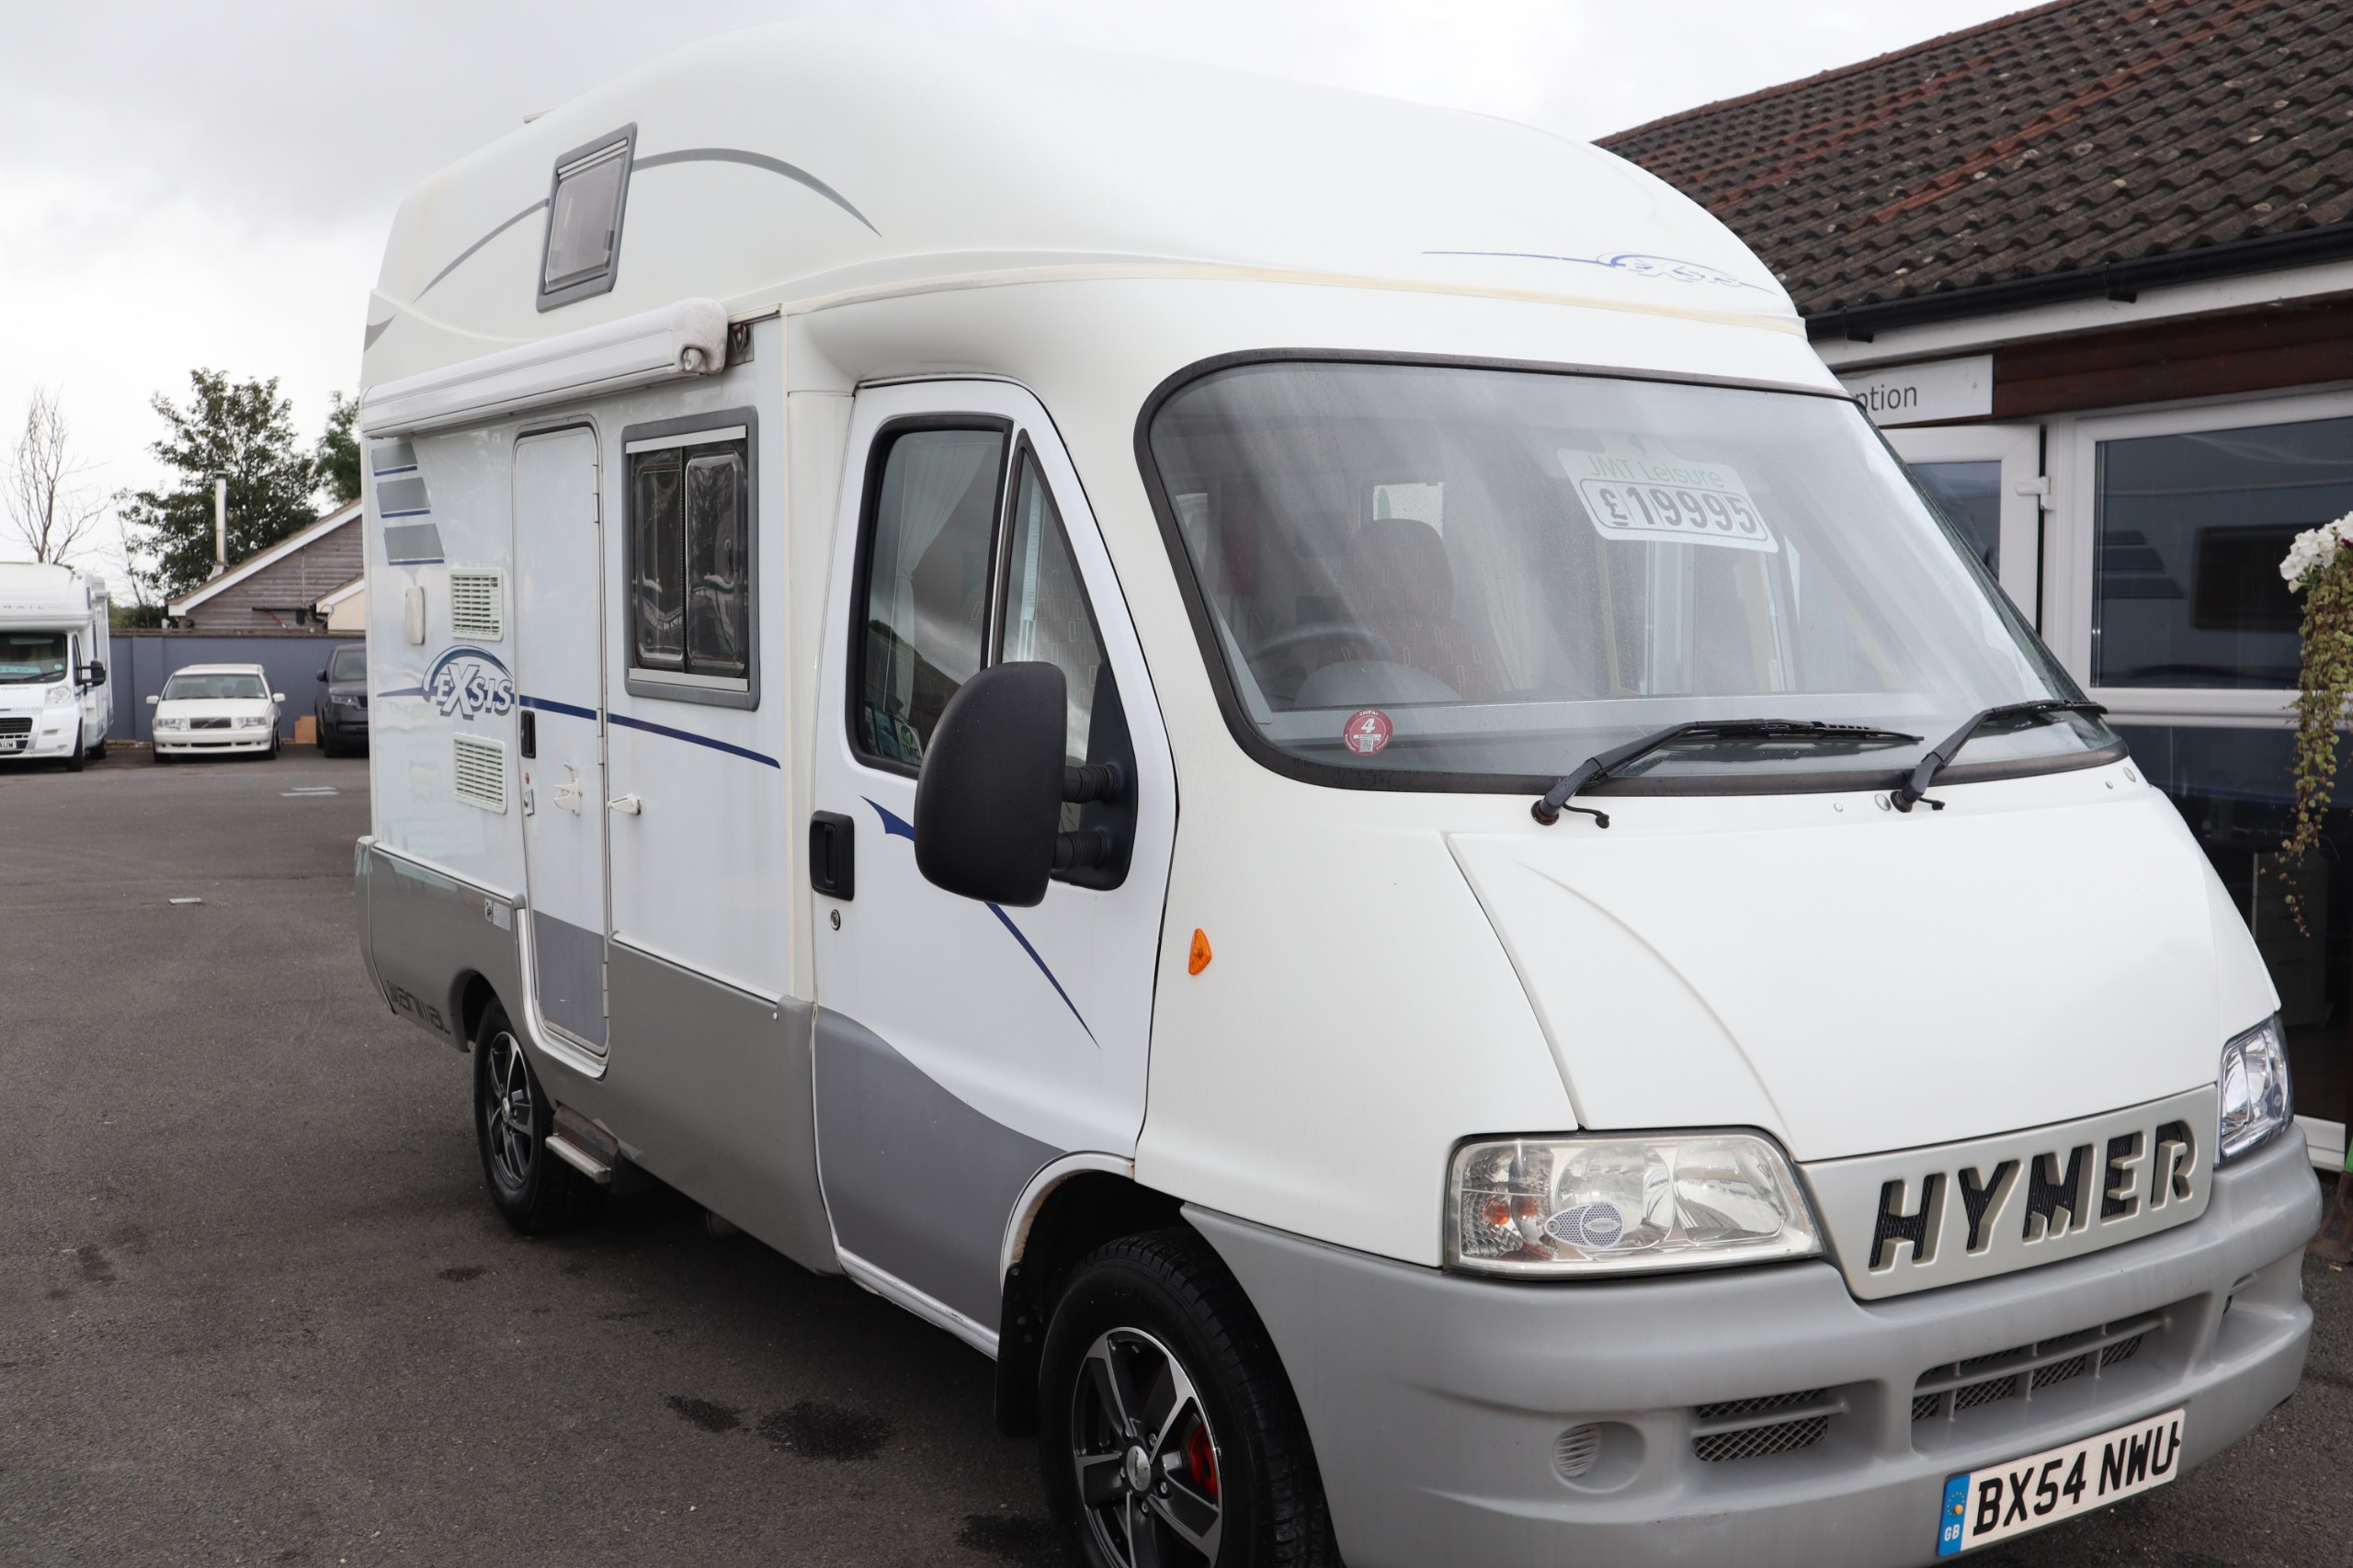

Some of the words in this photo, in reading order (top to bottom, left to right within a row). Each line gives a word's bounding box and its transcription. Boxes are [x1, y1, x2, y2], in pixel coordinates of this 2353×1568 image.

[1587, 455, 1635, 479] JMT
[1639, 457, 1724, 489] Leisure
[1598, 486, 1757, 534] £19995
[435, 663, 514, 722] EXSIS
[1360, 718, 1376, 734] 4
[1868, 1119, 2199, 1275] HYMER
[1972, 1451, 2087, 1537] BX54
[2097, 1421, 2179, 1496] NWU
[1944, 1524, 1961, 1542] GB
